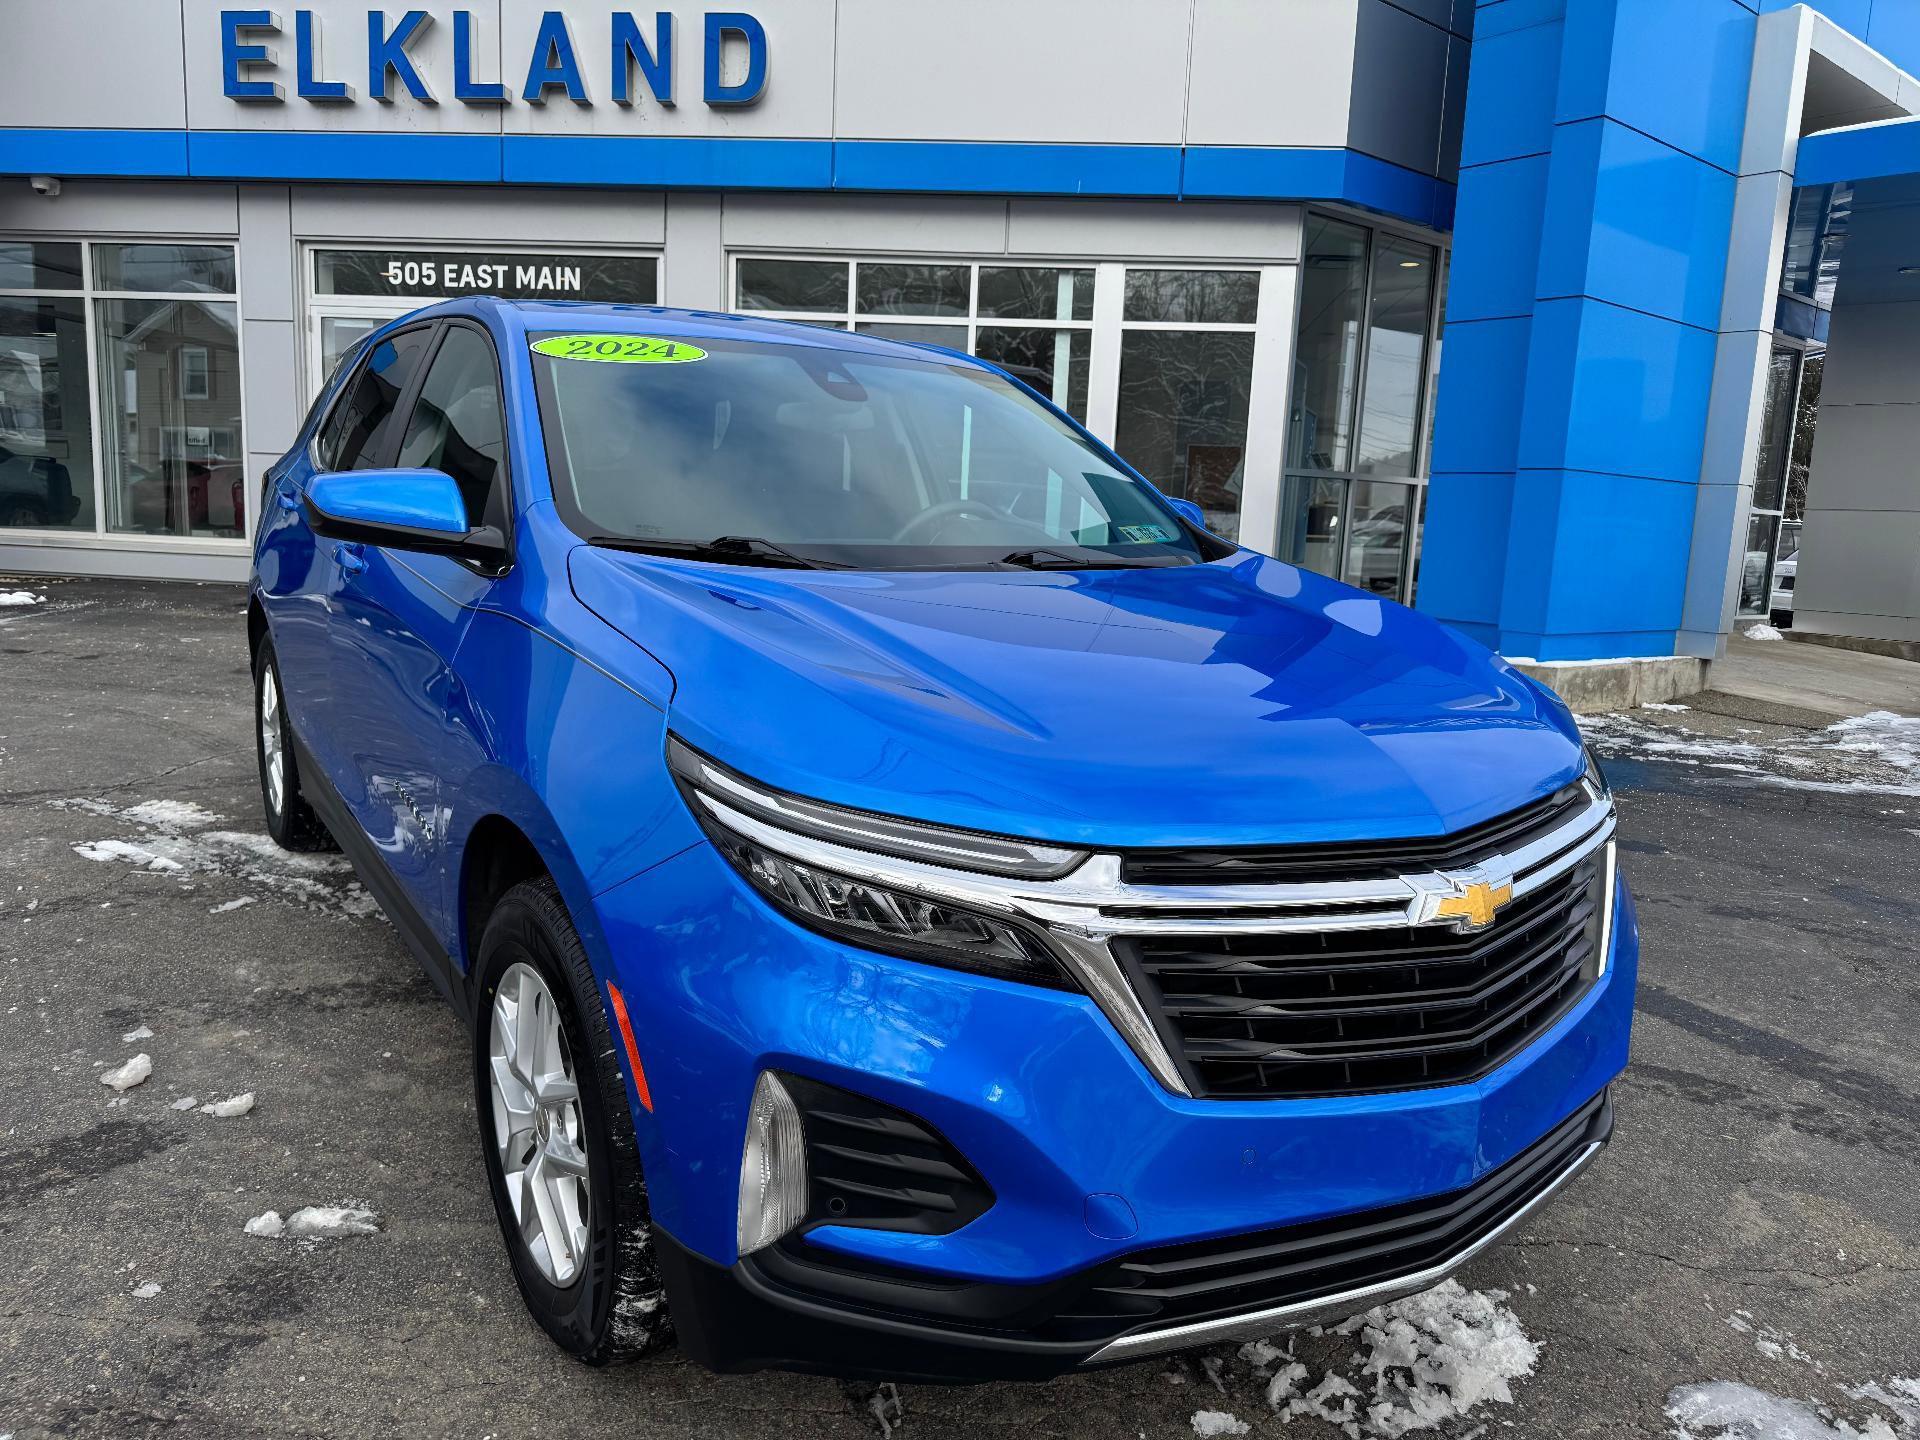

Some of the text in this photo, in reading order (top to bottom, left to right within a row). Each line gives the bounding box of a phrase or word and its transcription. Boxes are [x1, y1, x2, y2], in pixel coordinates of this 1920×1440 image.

[221, 9, 768, 107] ELKLAND
[388, 261, 581, 291] 505 EAST MAIN
[566, 340, 680, 358] 2024
